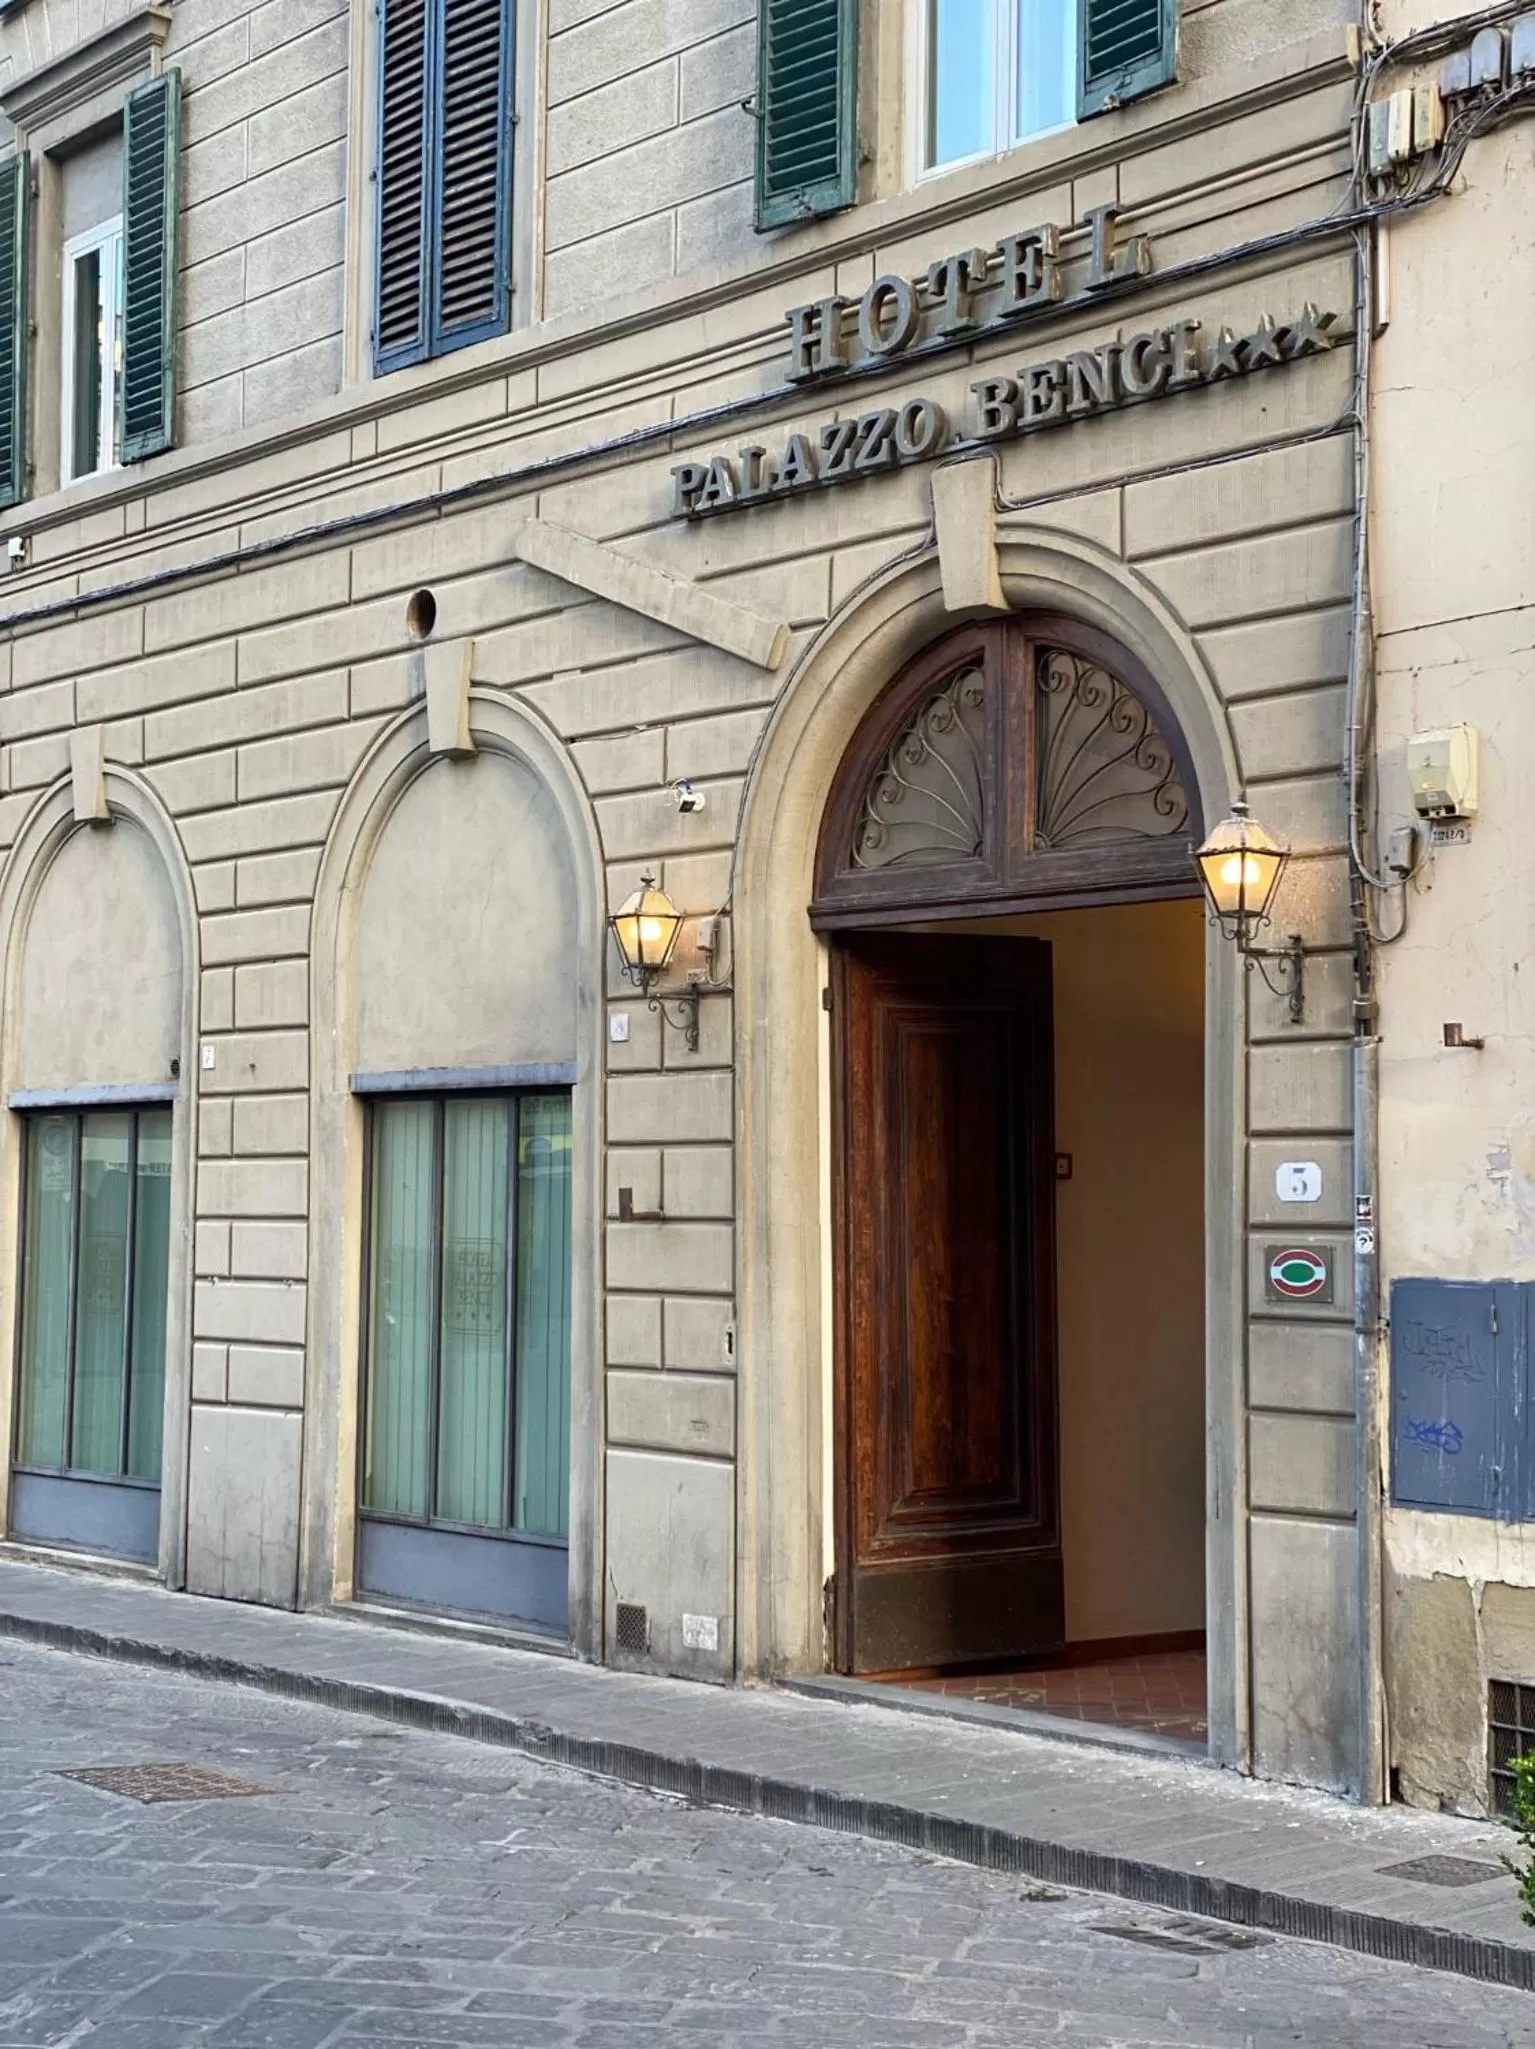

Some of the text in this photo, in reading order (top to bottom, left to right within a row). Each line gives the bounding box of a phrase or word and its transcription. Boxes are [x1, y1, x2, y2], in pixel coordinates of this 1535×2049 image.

[784, 203, 1151, 383] HOTEL
[670, 318, 1201, 517] PALAZZO BENCI
[1291, 1166, 1308, 1198] 5
